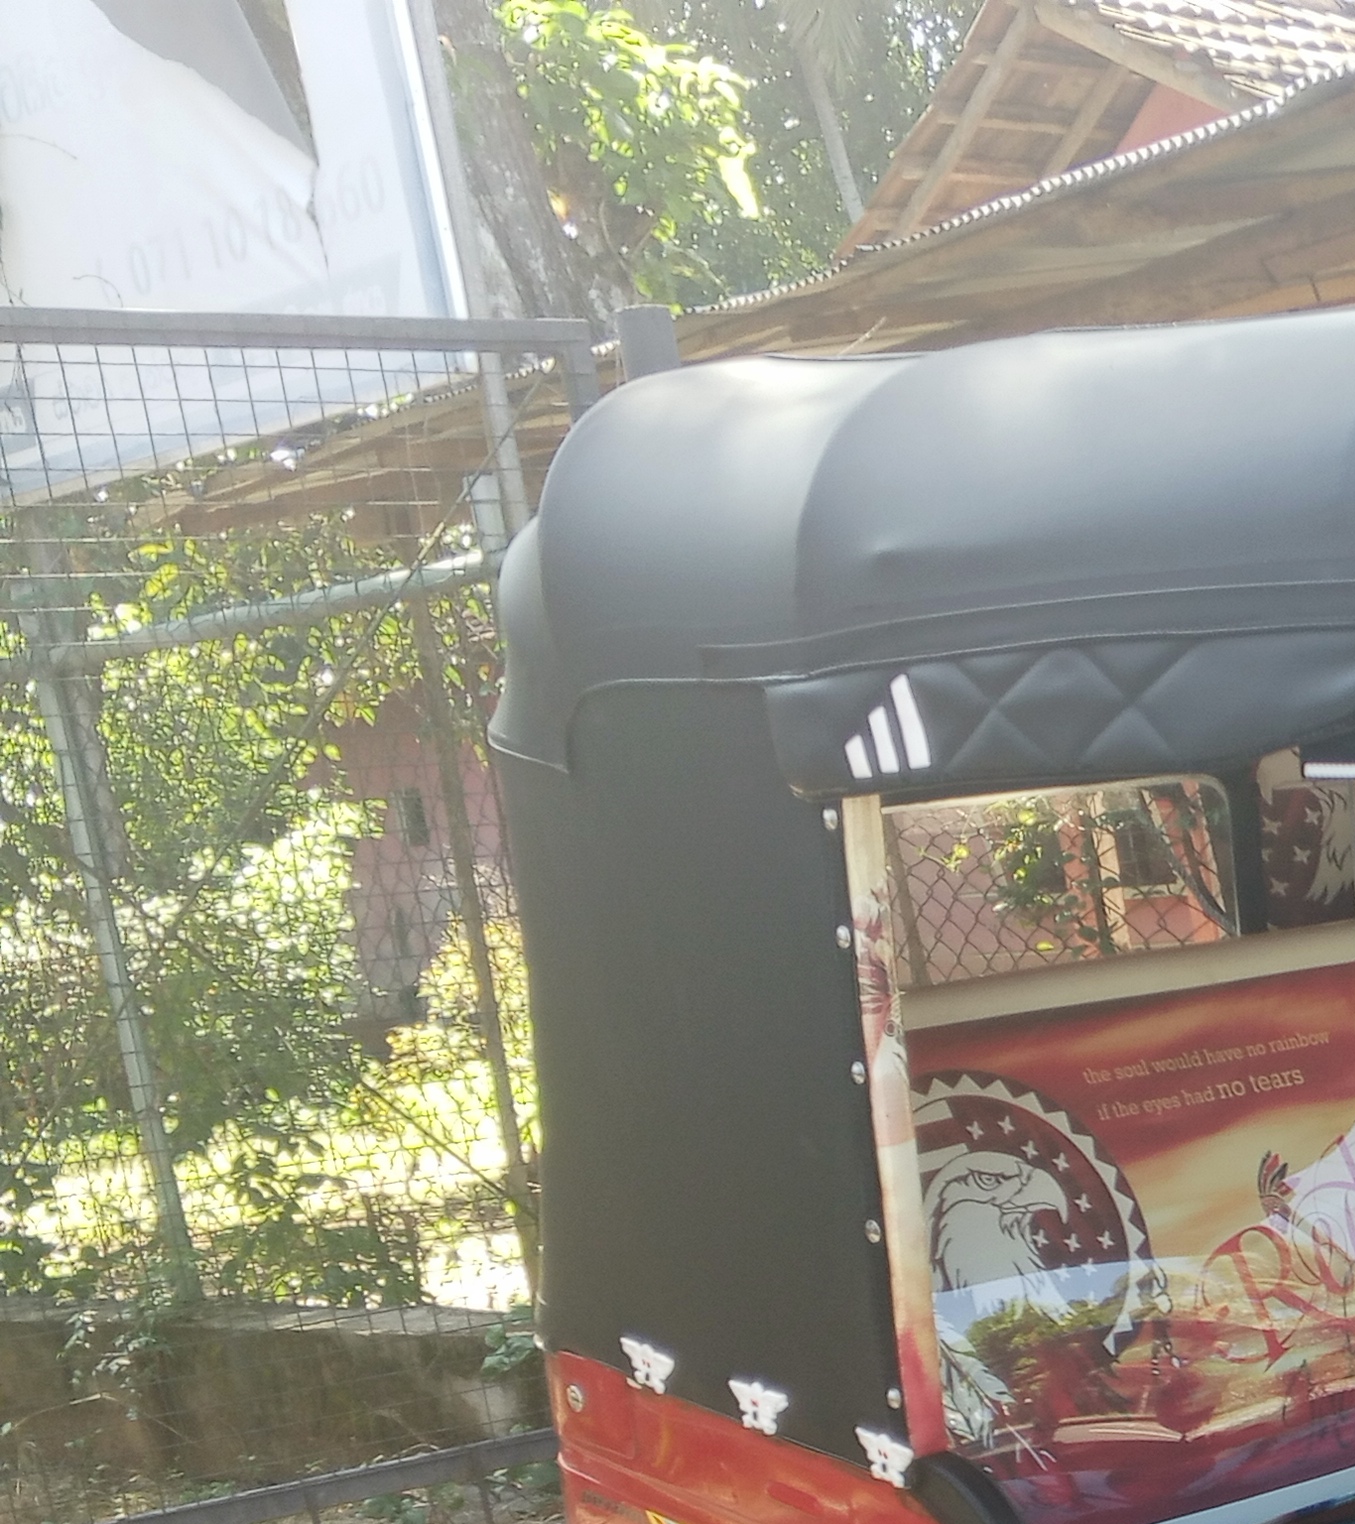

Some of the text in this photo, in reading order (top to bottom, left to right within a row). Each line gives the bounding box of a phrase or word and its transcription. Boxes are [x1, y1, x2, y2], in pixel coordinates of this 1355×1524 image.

[1082, 1030, 1330, 1085] the soul would have no rainbow
[1098, 1067, 1306, 1122] if the eyes had no tears
